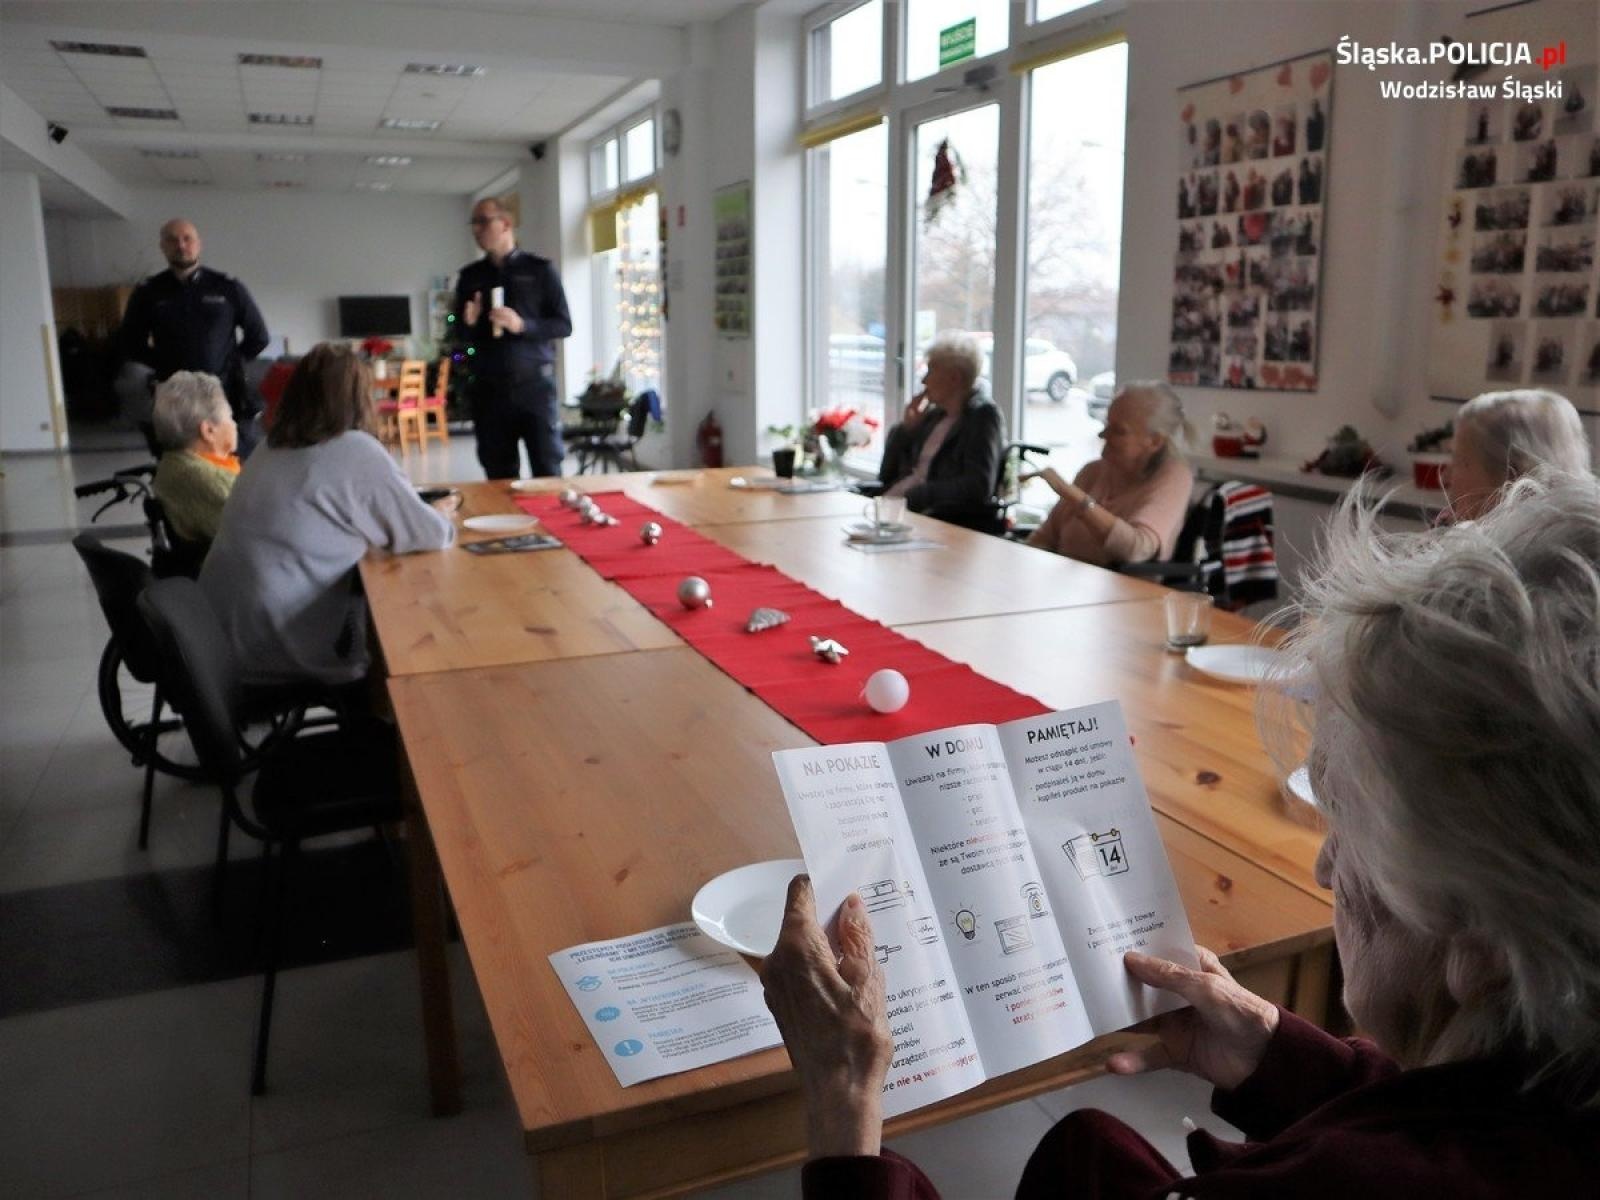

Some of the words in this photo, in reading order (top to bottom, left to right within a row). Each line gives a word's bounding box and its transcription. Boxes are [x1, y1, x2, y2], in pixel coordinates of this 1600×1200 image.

[1026, 717, 1099, 744] PAMIĘTAJ!
[925, 743, 940, 759] W
[944, 735, 984, 755] DOMU
[802, 760, 825, 776] NA
[826, 754, 881, 773] POKAZIE
[1099, 844, 1122, 867] 14
[886, 1003, 914, 1019] potkań
